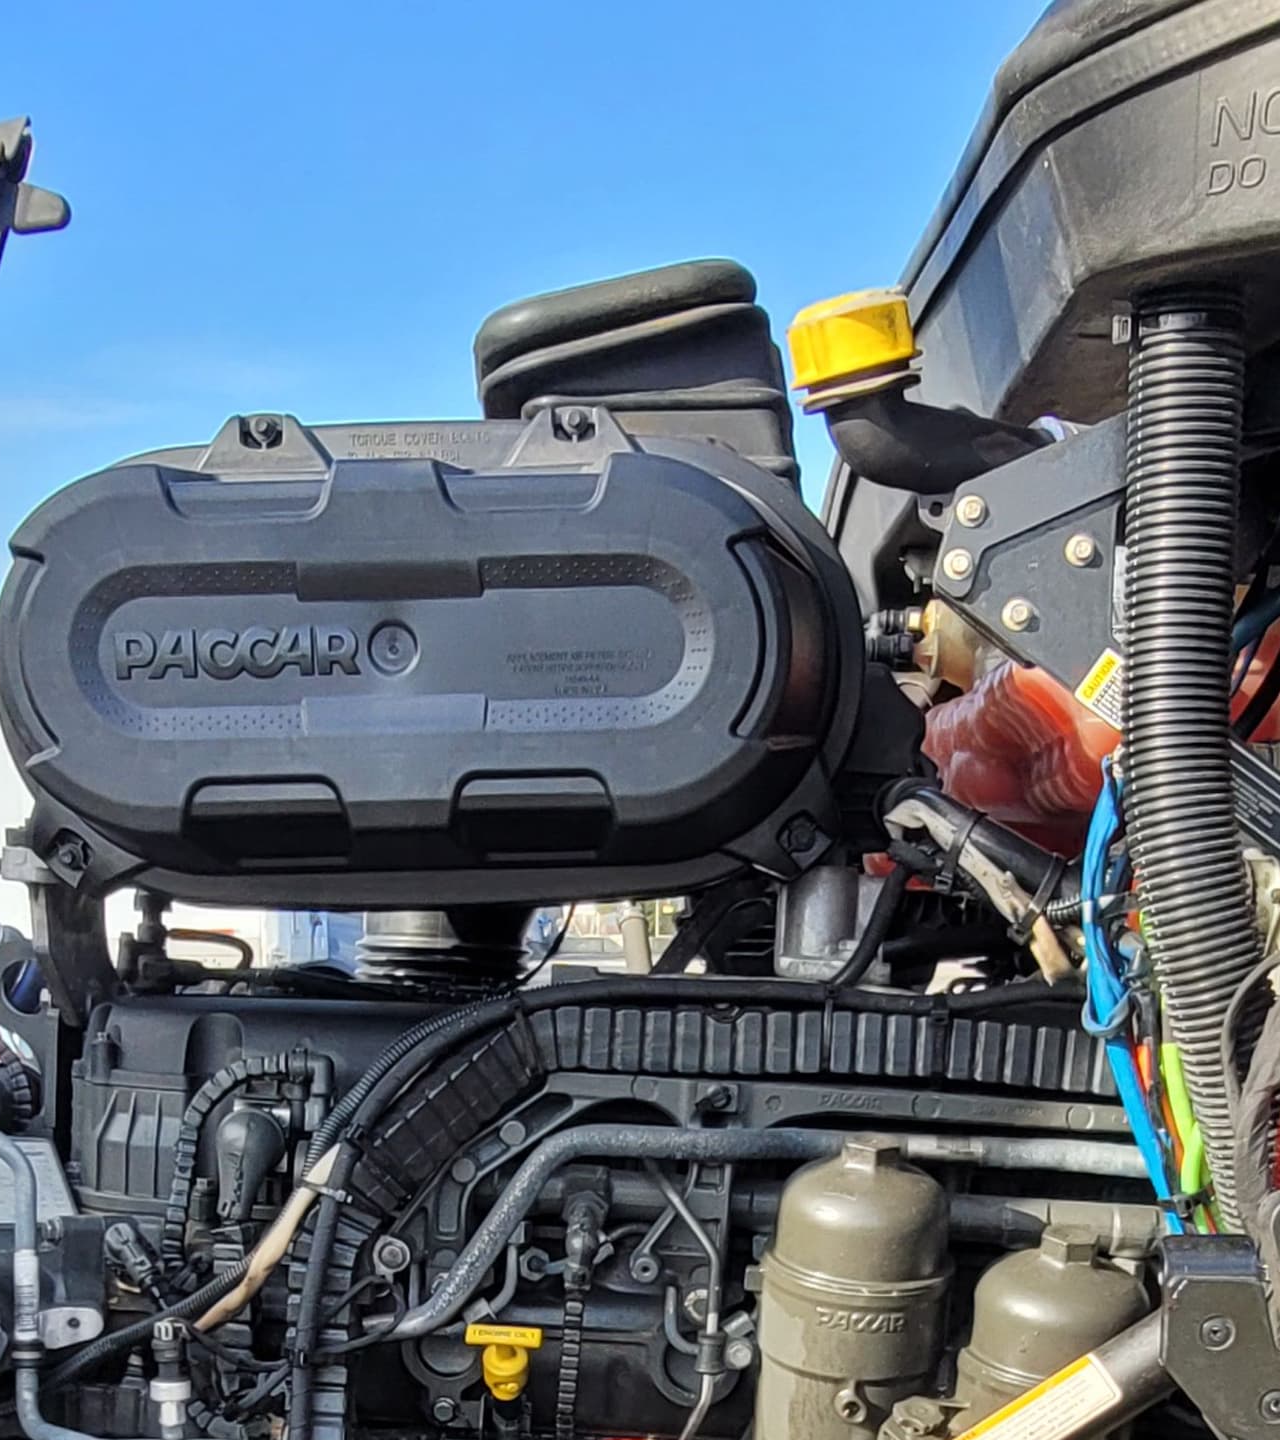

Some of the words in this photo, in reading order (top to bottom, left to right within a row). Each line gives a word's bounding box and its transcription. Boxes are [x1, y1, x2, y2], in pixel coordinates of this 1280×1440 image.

[1206, 154, 1267, 196] DO
[114, 625, 361, 681] PACCAR
[1082, 656, 1116, 699] CAUTION
[815, 1306, 905, 1335] PACCAR
